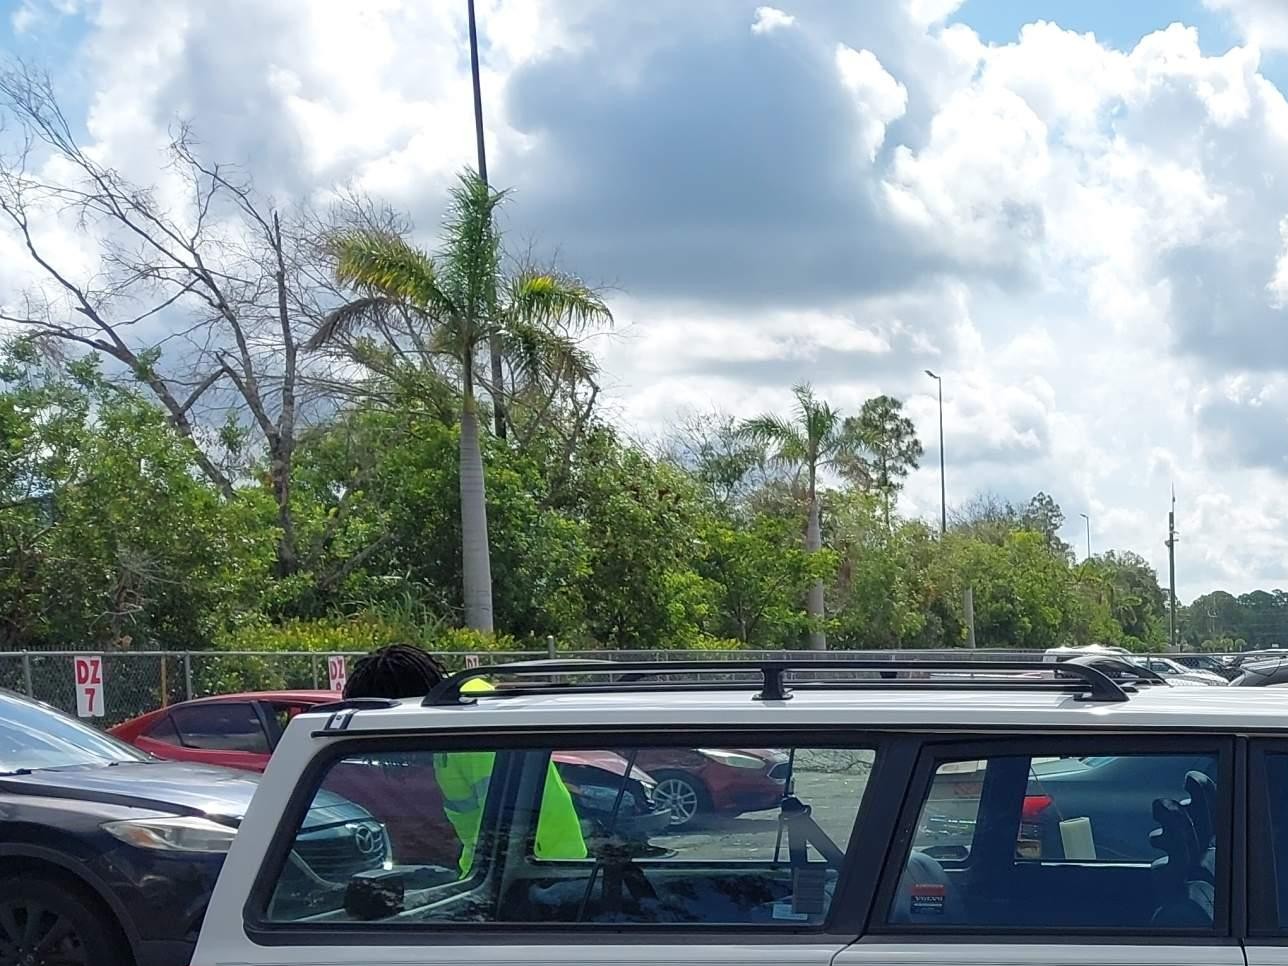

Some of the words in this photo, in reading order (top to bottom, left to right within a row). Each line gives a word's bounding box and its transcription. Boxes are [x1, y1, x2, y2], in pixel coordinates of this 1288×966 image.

[76, 660, 101, 684] DZ
[330, 659, 345, 680] DZ
[84, 688, 96, 712] 7
